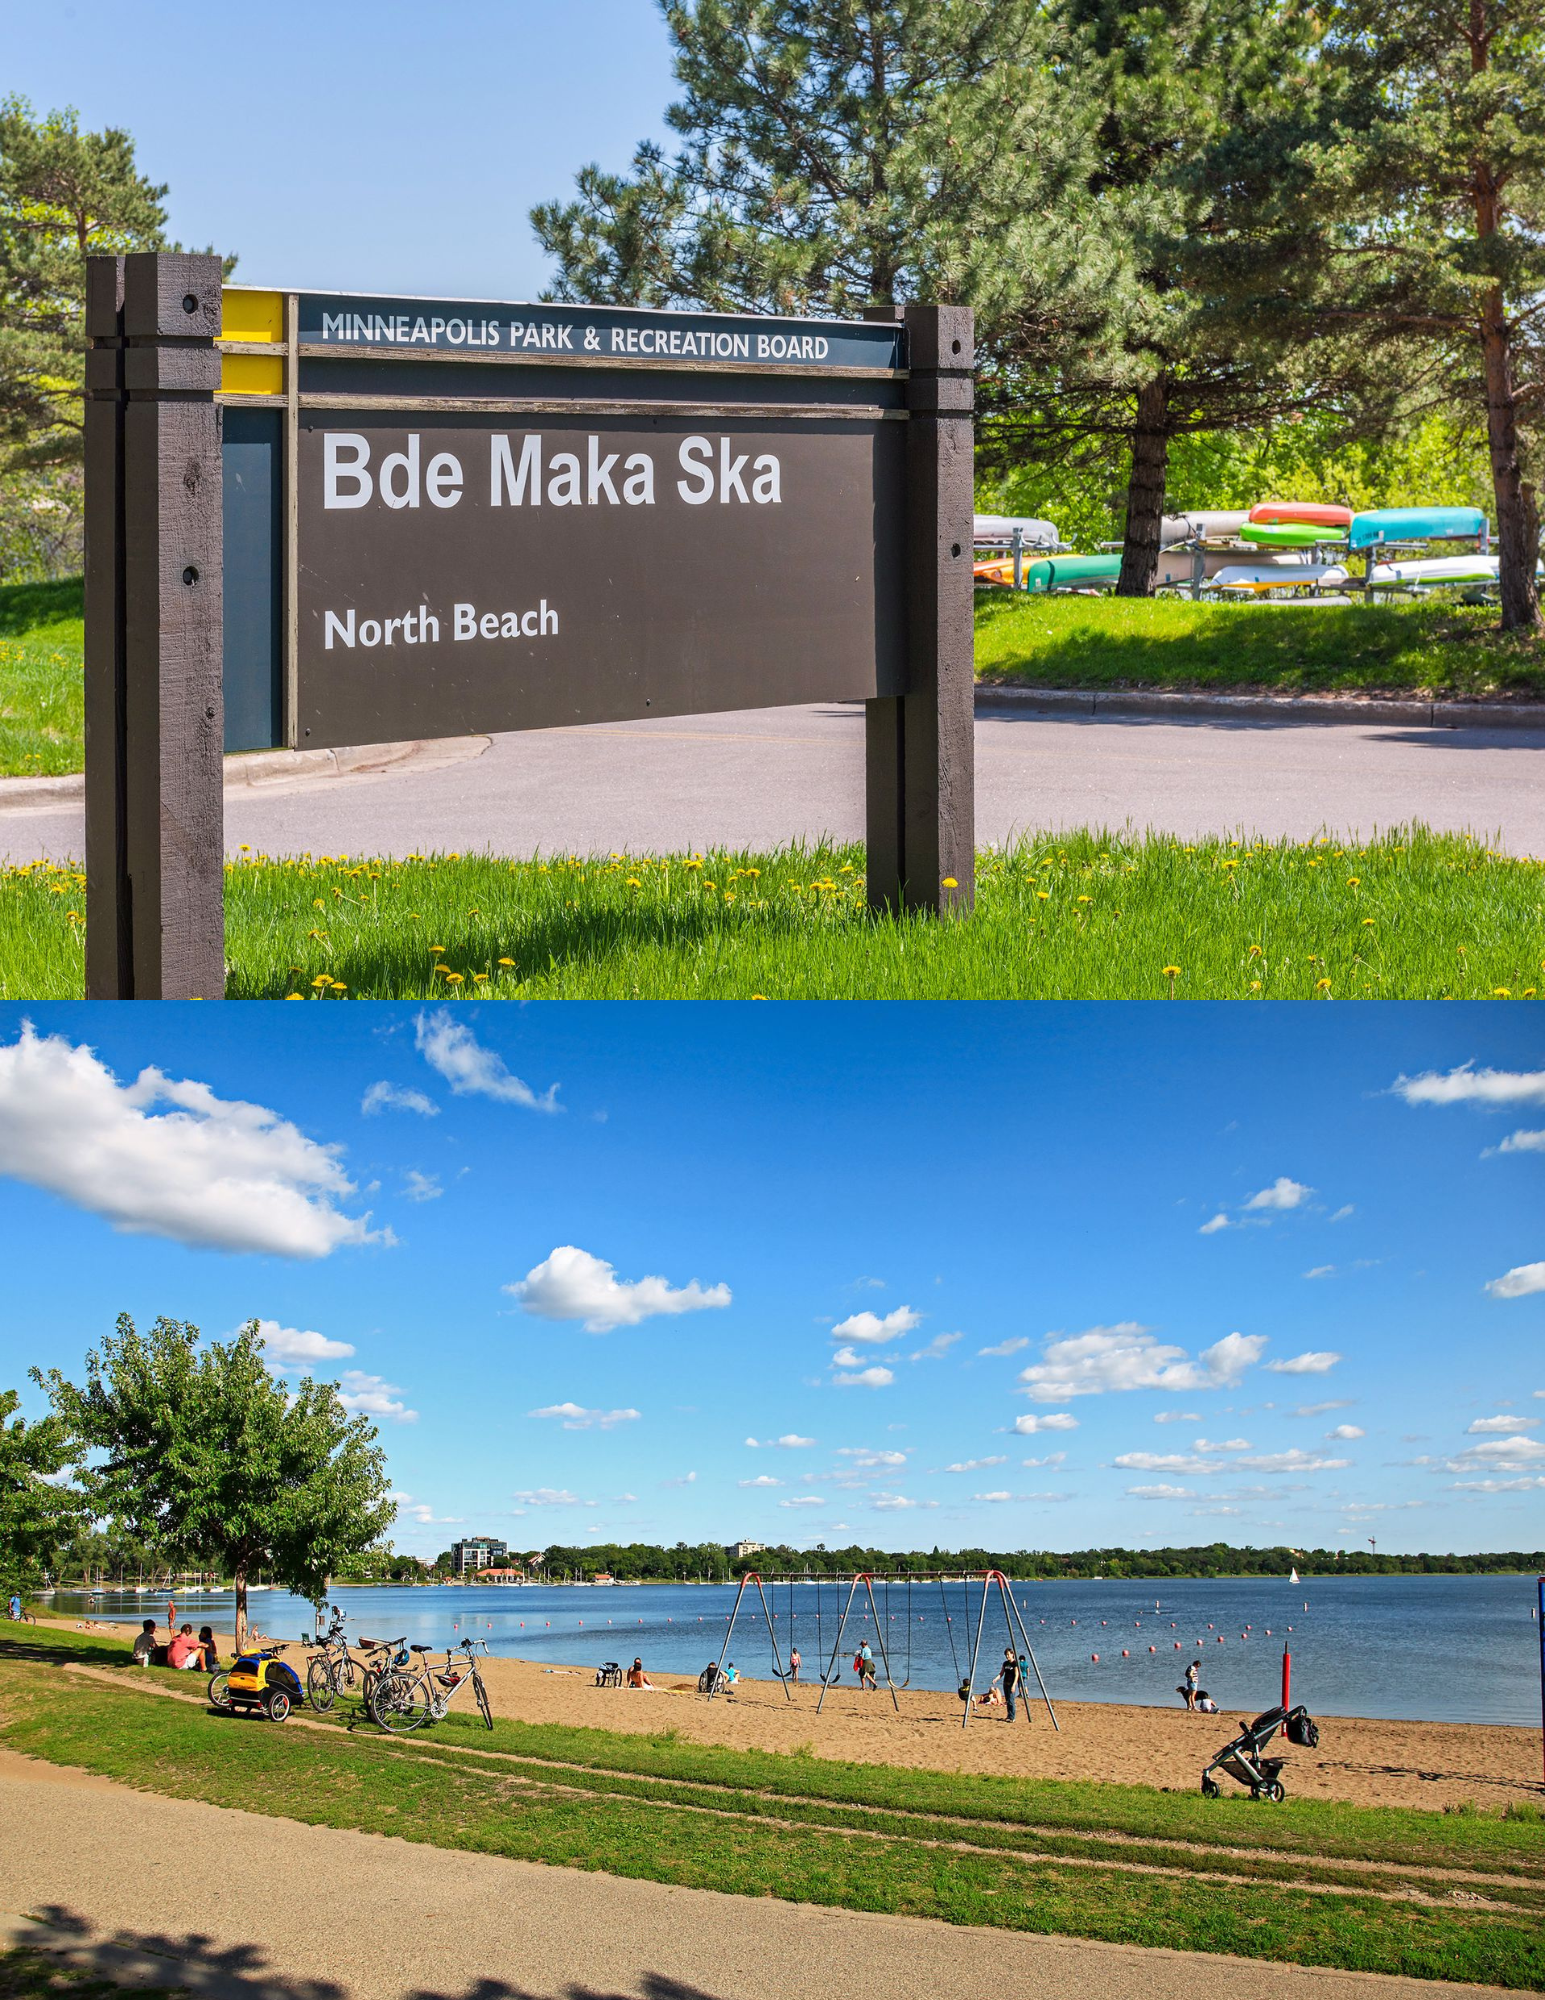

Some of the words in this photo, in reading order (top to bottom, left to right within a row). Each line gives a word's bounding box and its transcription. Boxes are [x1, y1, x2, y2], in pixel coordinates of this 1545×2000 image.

[321, 313, 500, 347] MINNEAPOLIS
[510, 322, 574, 351] PARK
[583, 325, 602, 351] &
[611, 328, 750, 358] RECREATION
[757, 334, 829, 360] BOARD
[323, 432, 464, 510] Bde
[490, 434, 656, 507] Maka
[676, 435, 783, 507] Ska
[324, 604, 440, 650] North
[453, 598, 560, 641] Beach
